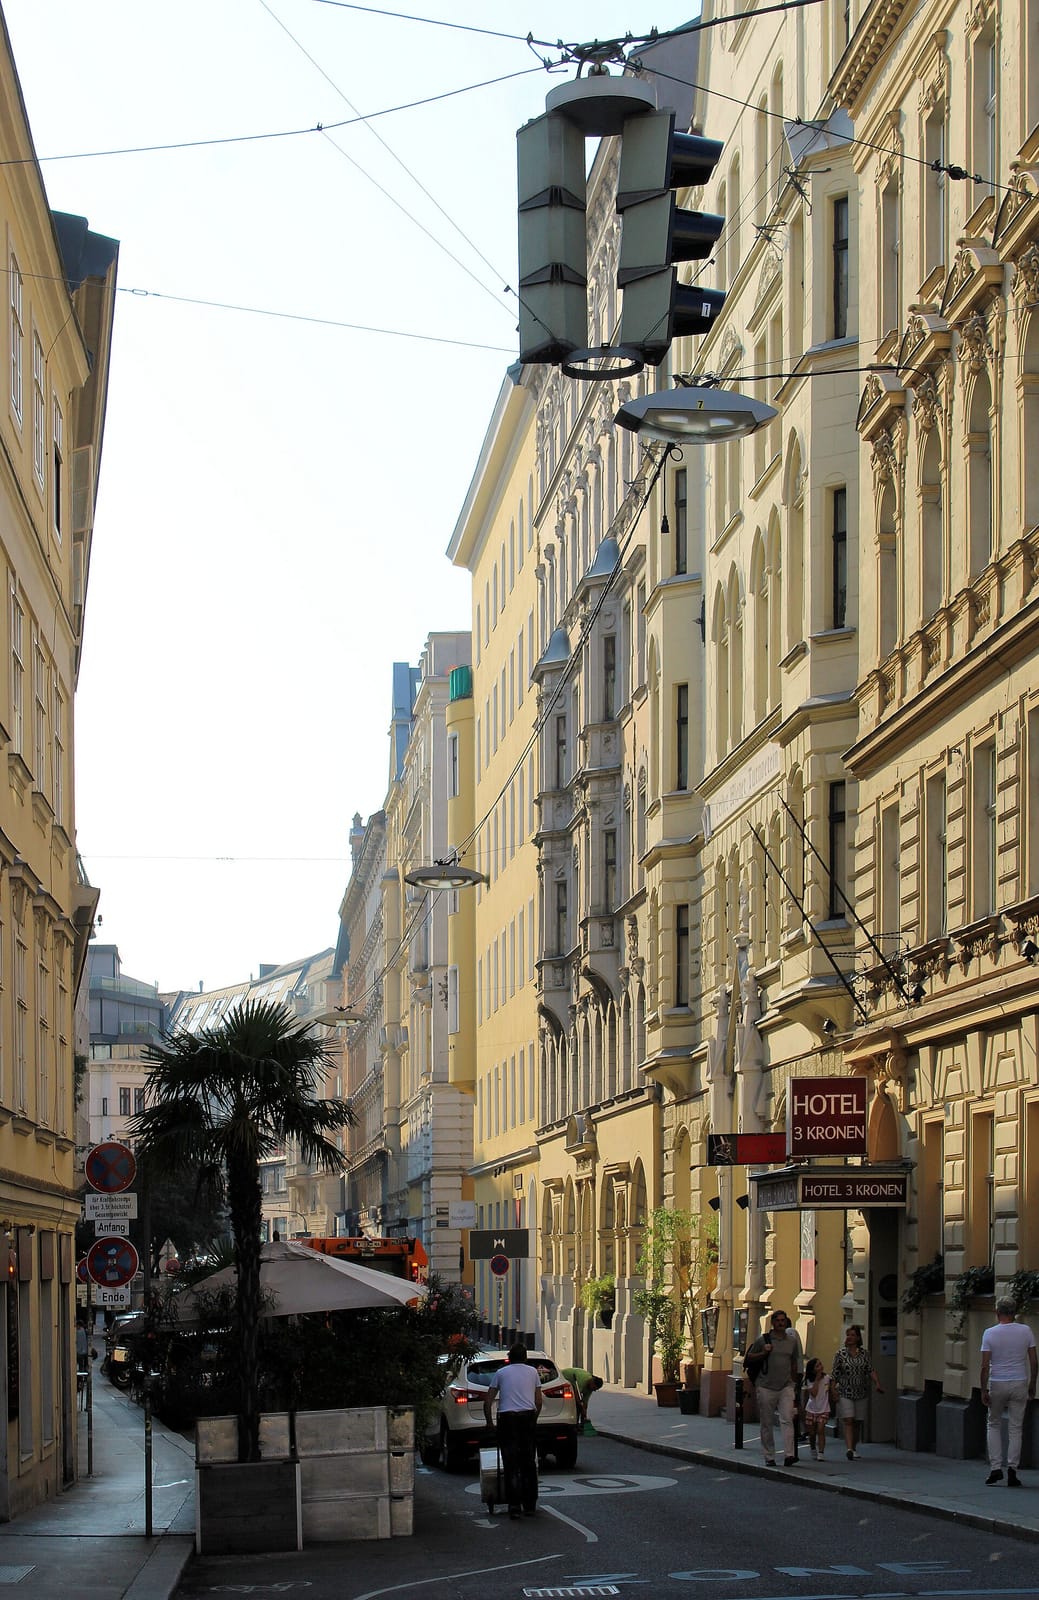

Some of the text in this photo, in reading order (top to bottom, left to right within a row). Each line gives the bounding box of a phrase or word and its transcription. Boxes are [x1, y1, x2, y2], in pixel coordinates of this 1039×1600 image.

[793, 1094, 865, 1116] HOTEL
[793, 1125, 865, 1140] 3 KRONEN
[804, 1184, 842, 1197] HOTEL
[845, 1184, 853, 1196] 3
[856, 1183, 903, 1196] KRONEN
[98, 1222, 126, 1233] Anfang
[102, 1292, 125, 1302] Ende
[563, 1560, 973, 1587] ZONE
